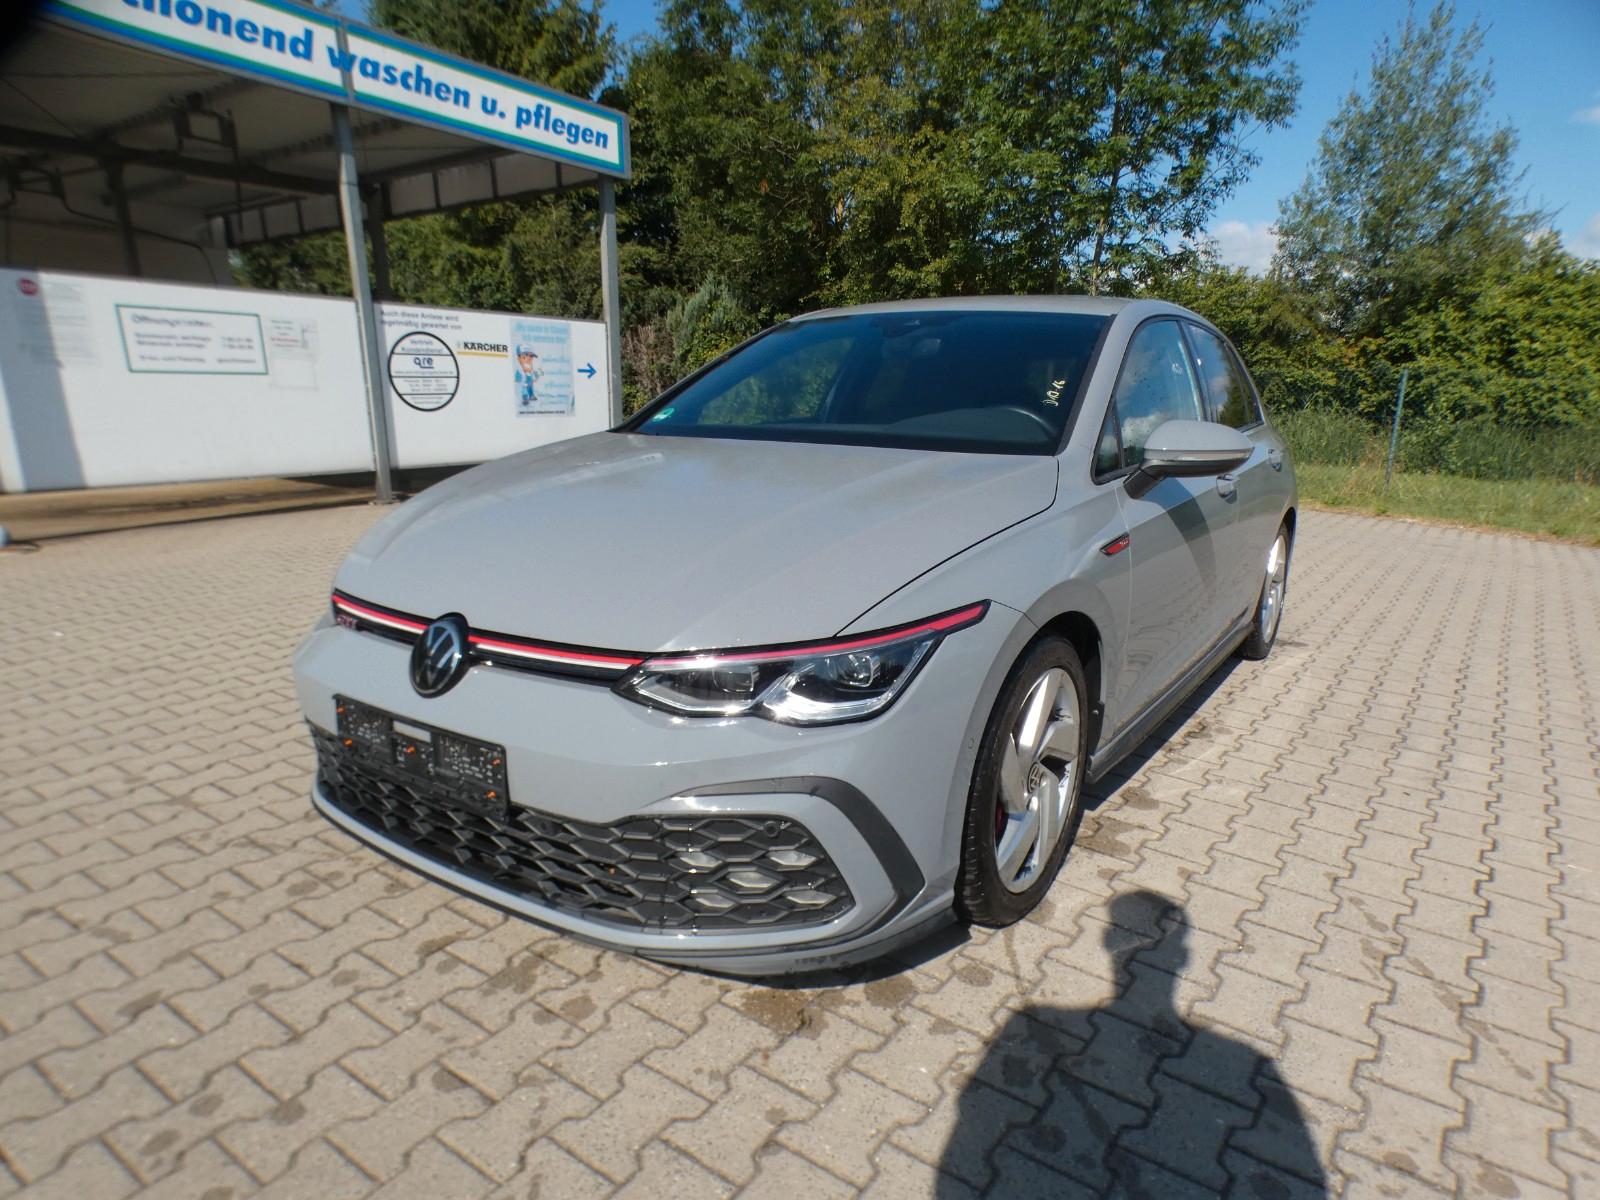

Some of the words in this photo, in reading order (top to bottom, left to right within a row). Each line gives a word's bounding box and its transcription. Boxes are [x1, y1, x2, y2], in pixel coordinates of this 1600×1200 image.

[326, 45, 471, 109] waschen
[481, 94, 507, 119] u.
[515, 103, 610, 150] pflegen
[463, 341, 509, 353] KÄRCHER
